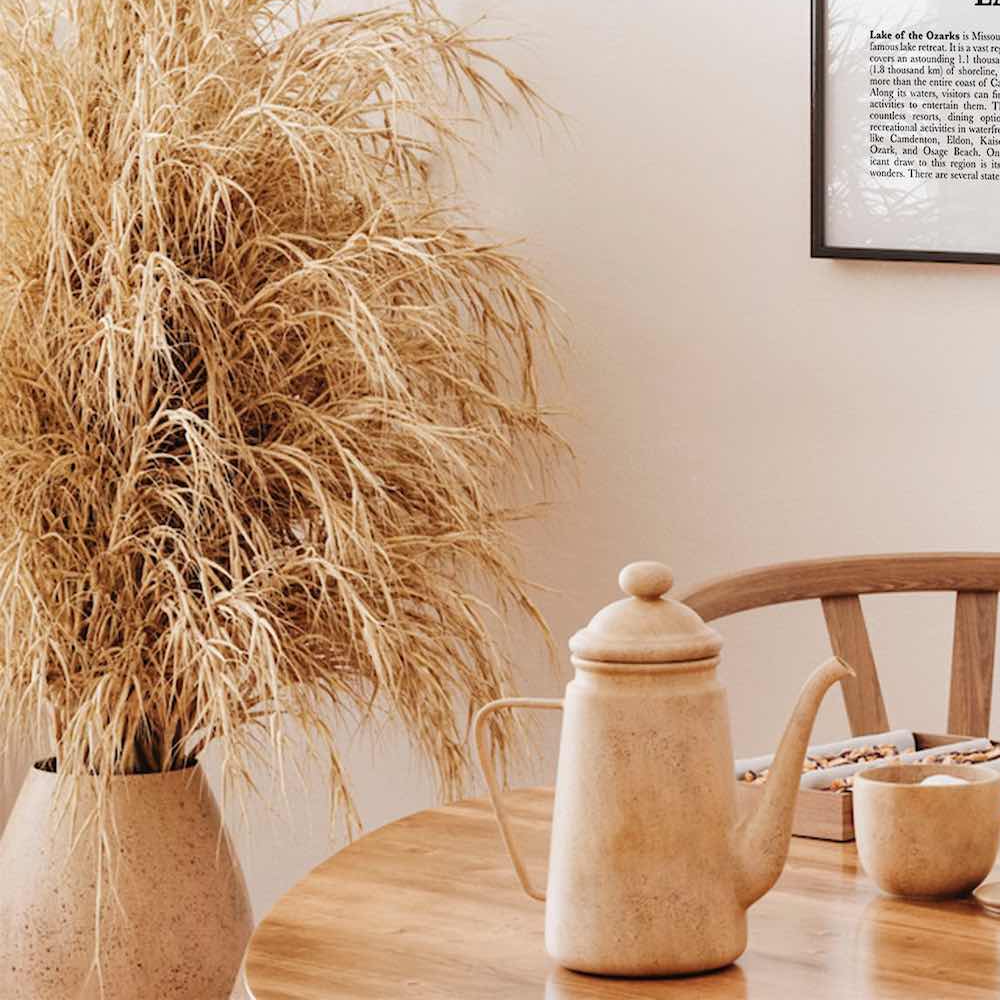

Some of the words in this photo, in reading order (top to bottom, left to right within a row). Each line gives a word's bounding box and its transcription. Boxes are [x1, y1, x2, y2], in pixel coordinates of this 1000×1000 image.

[870, 30, 892, 39] Lake
[894, 30, 905, 39] of
[908, 31, 923, 40] the
[926, 31, 960, 40] Ozarks
[962, 32, 969, 40] is
[910, 54, 954, 65] astounding
[892, 76, 911, 85] than
[913, 77, 926, 86] the
[928, 78, 952, 86] entire
[978, 78, 987, 87] of
[869, 100, 904, 108] activities
[922, 101, 958, 109] entertain
[869, 110, 906, 120] countless
[947, 112, 974, 124] dining
[870, 122, 917, 132] recreational
[920, 124, 955, 132] activities
[957, 124, 966, 133] in
[869, 133, 884, 142] like
